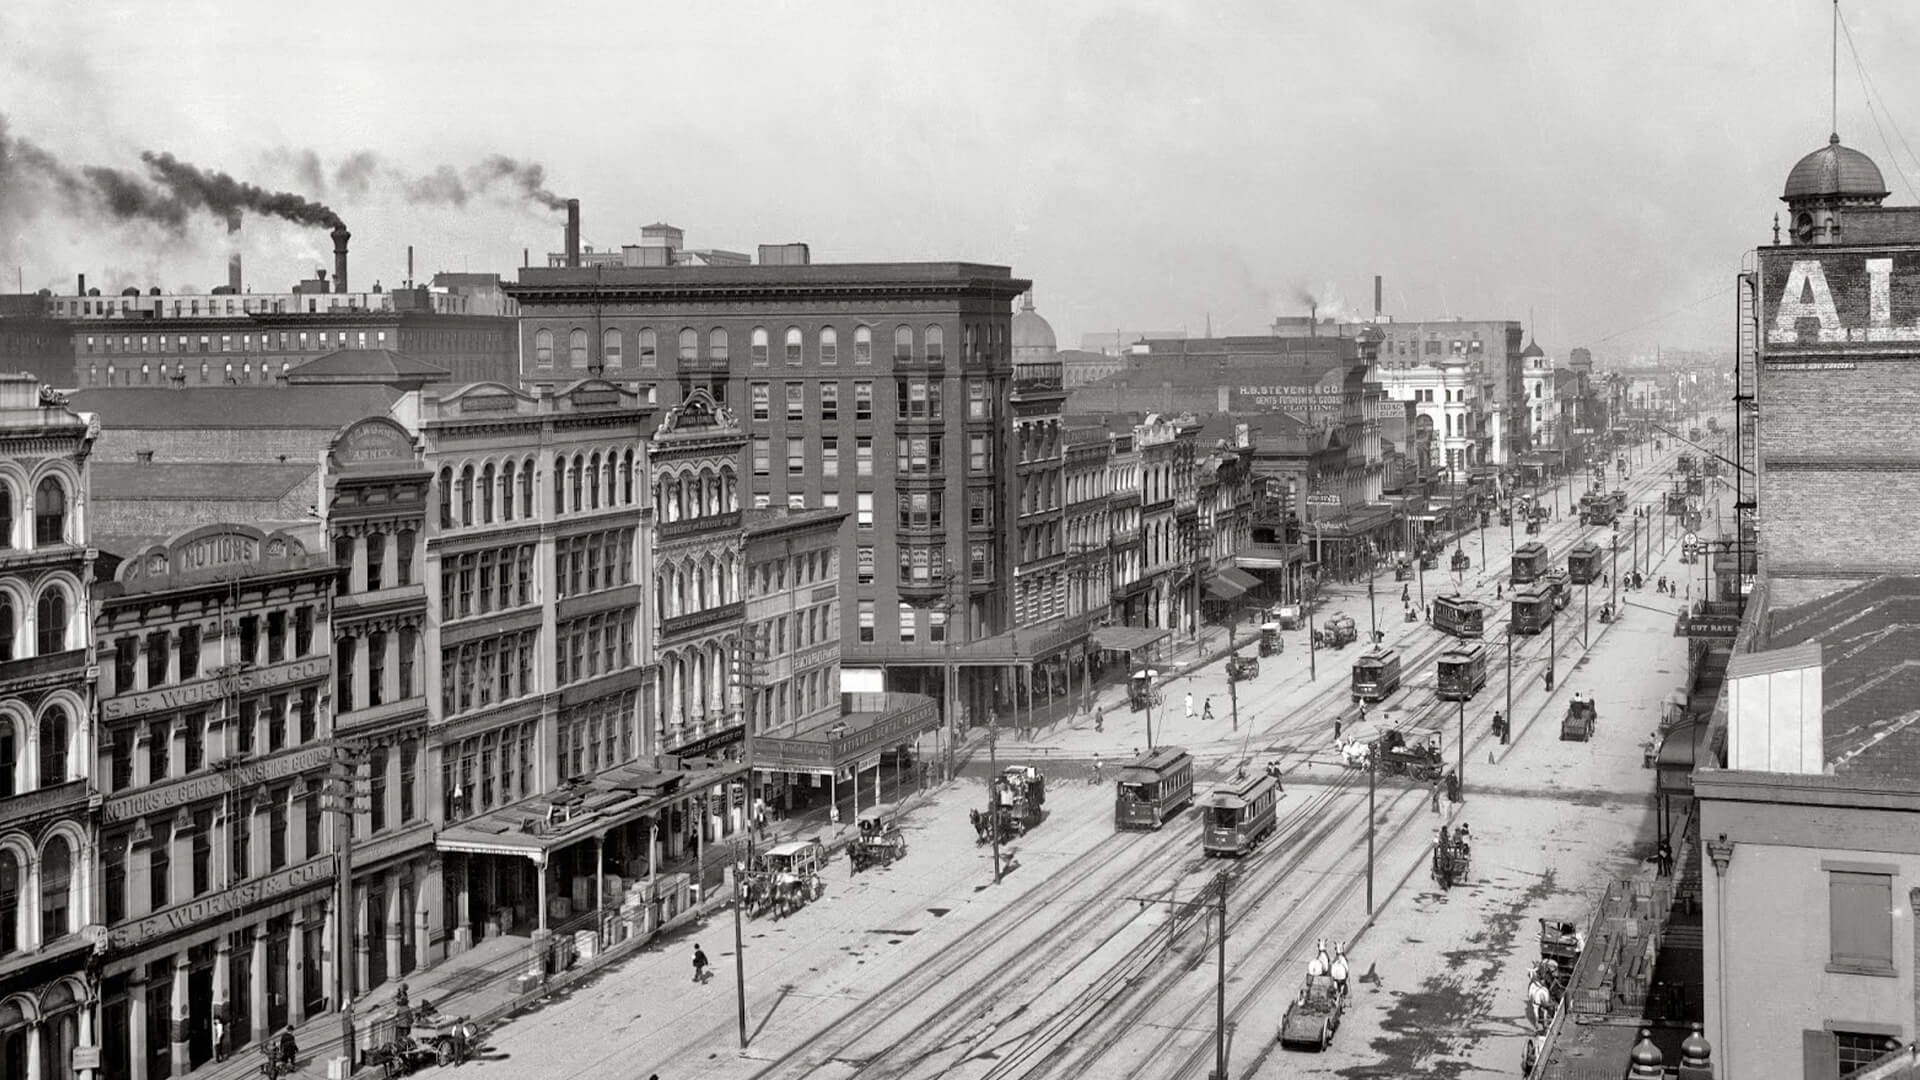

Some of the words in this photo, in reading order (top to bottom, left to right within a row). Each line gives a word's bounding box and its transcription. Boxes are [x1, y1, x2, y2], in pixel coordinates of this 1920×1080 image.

[1261, 385, 1312, 395] STEVENS
[184, 538, 253, 568] NOTIONS
[1691, 624, 1707, 632] CUT
[1710, 624, 1733, 632] RATE
[160, 676, 253, 708] WORMS
[261, 673, 278, 685] &
[104, 793, 161, 824] NOTIONS
[163, 791, 175, 806] &
[223, 757, 289, 790] FURNISHING
[292, 749, 329, 770] GOODS
[167, 885, 256, 929] WORMS
[265, 877, 282, 892] &
